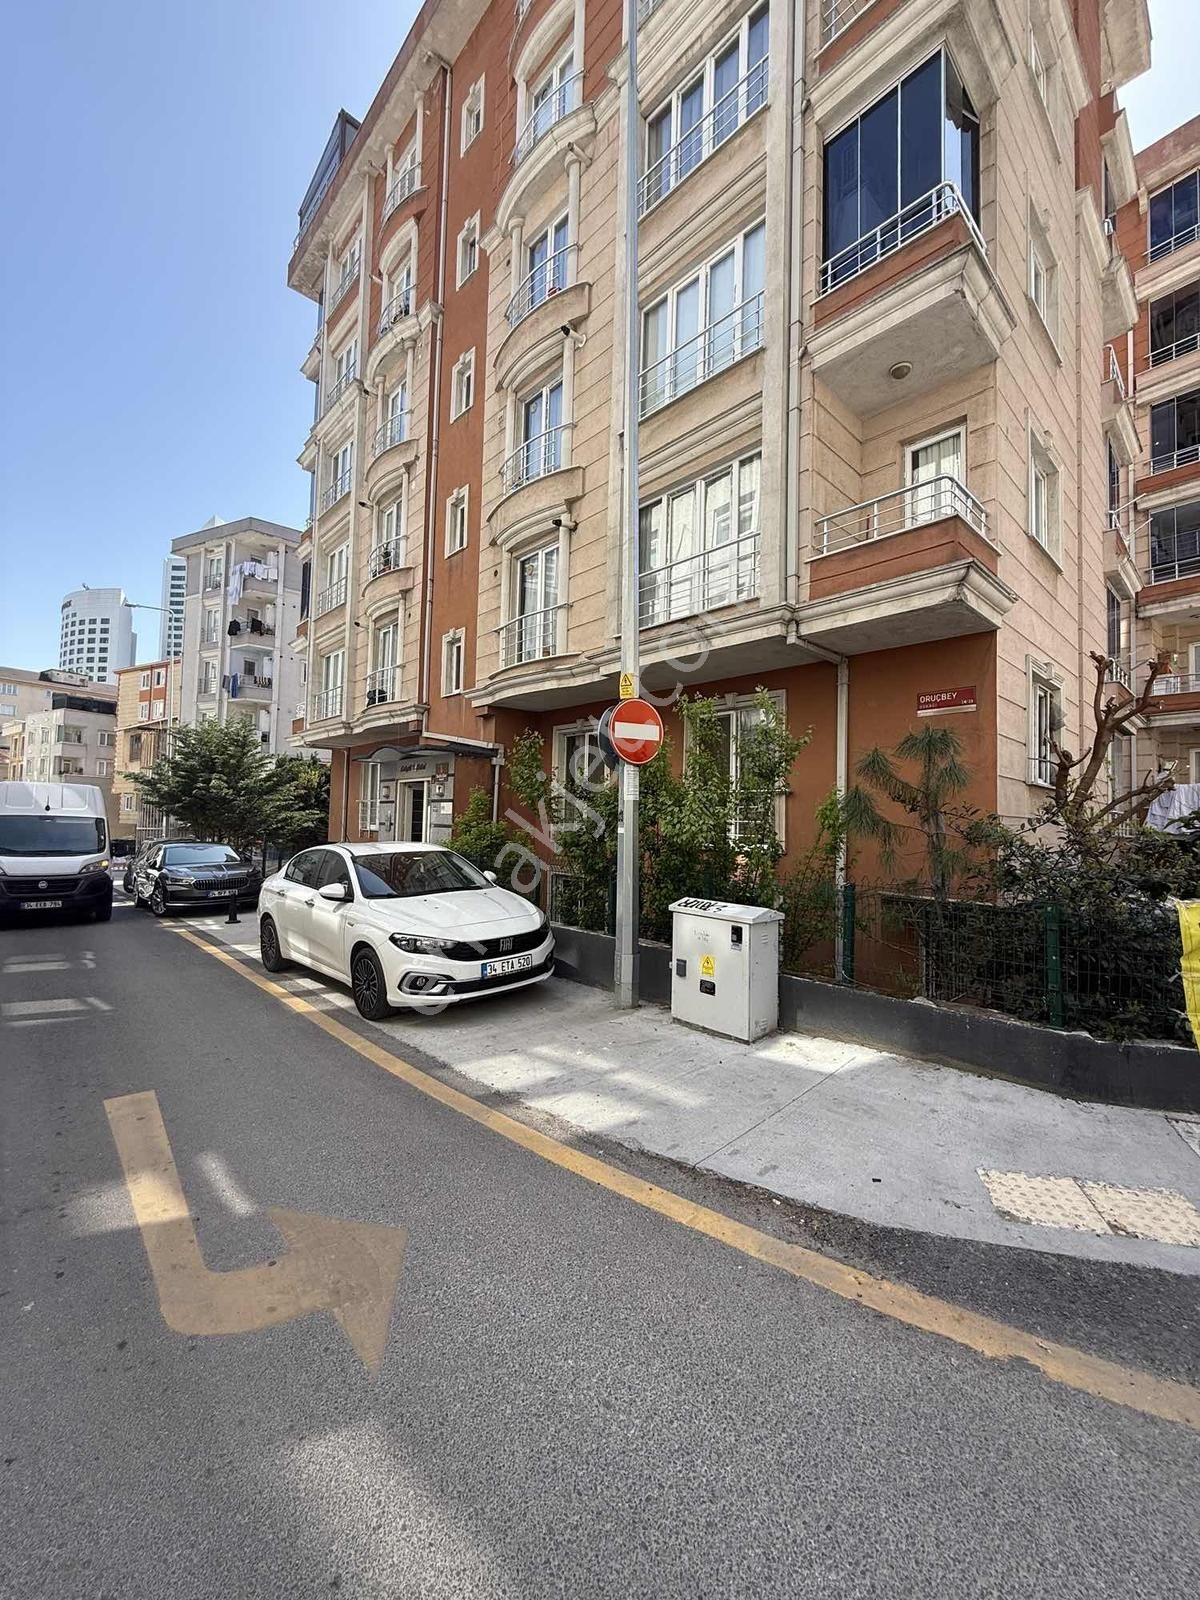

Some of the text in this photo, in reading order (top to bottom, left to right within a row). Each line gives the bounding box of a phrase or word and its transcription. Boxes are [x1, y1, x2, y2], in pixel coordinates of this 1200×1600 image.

[919, 691, 957, 703] ORUÇBEY
[499, 937, 514, 952] FIAT
[488, 963, 497, 975] 34
[501, 959, 515, 972] ETA
[518, 956, 530, 968] 520
